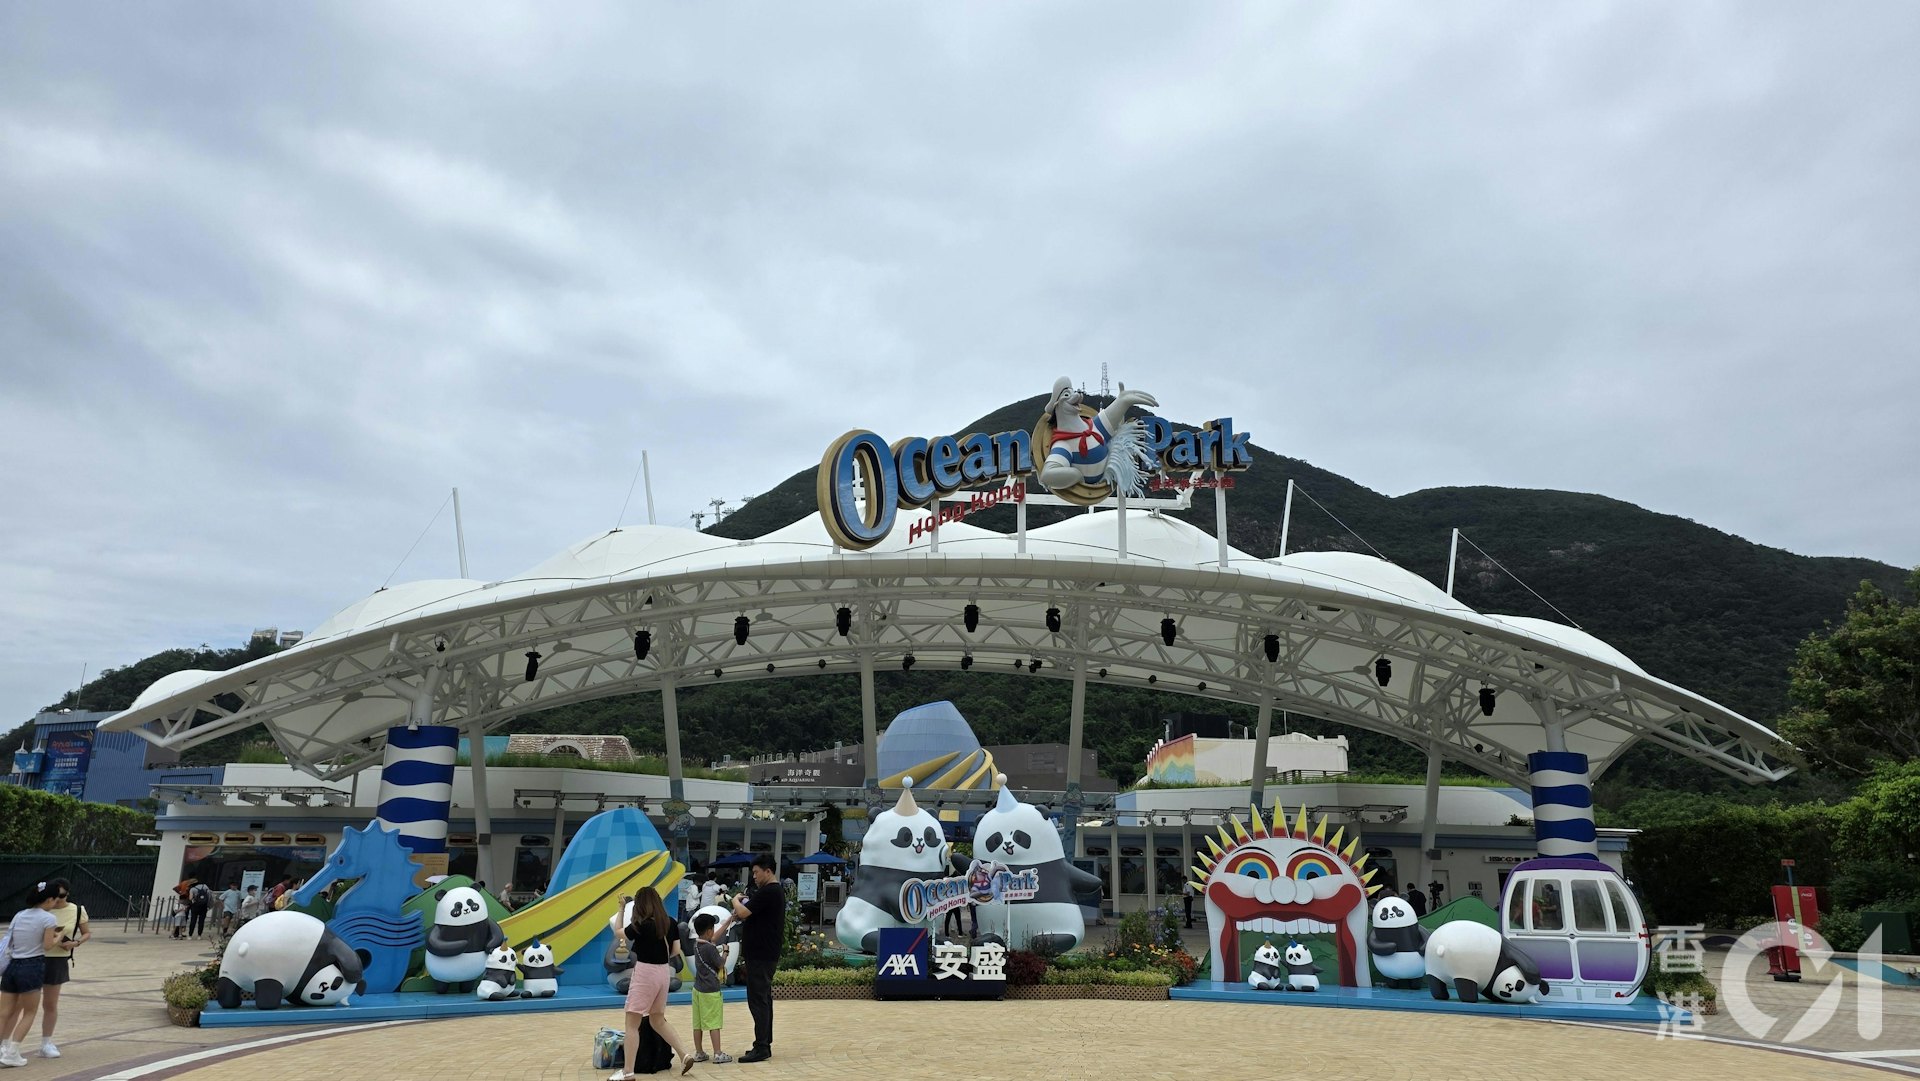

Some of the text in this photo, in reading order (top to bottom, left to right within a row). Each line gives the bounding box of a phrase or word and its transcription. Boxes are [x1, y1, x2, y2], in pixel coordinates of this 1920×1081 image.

[817, 416, 1253, 550] Ocean Park
[909, 482, 1025, 544] Hong Kong
[787, 769, 820, 777] 海洋奇觀
[902, 872, 1036, 921] Ocean Park
[929, 897, 967, 918] Hong Kong
[879, 954, 920, 976] AXA
[933, 941, 1007, 981] 安盛
